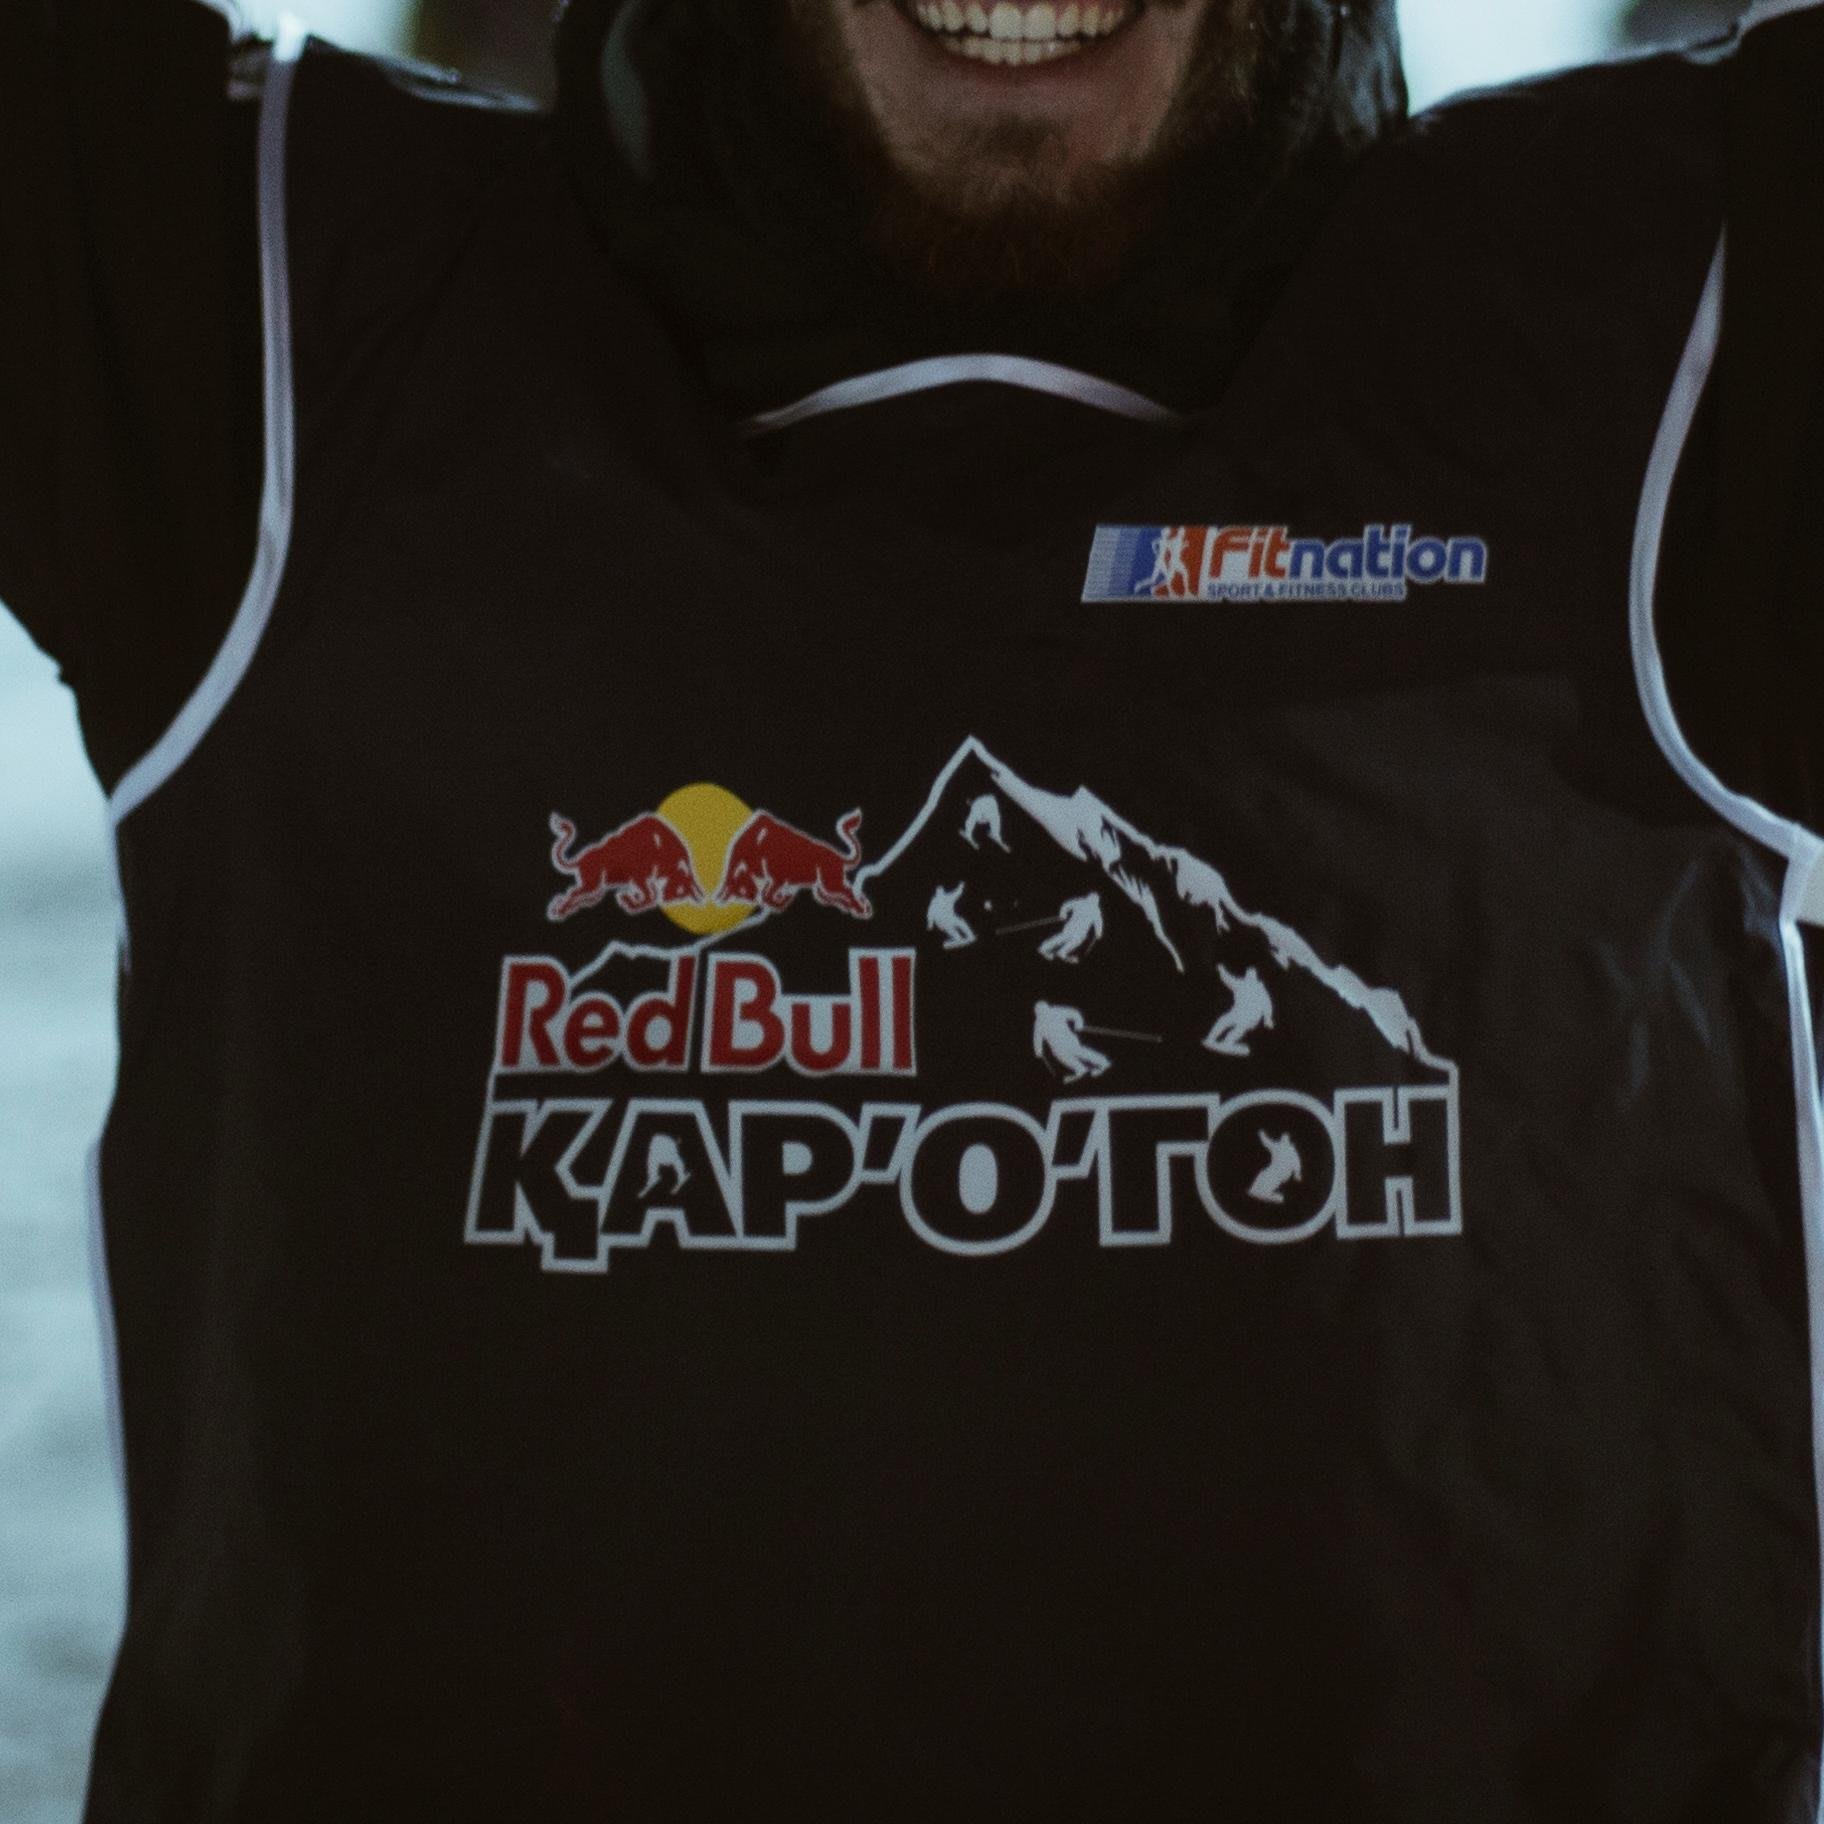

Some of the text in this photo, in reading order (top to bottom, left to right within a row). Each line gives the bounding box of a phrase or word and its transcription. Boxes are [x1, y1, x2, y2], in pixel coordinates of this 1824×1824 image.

[1207, 582, 1405, 598] SPORT & FITNESS CLUBS
[500, 947, 917, 1076] Red Bull
